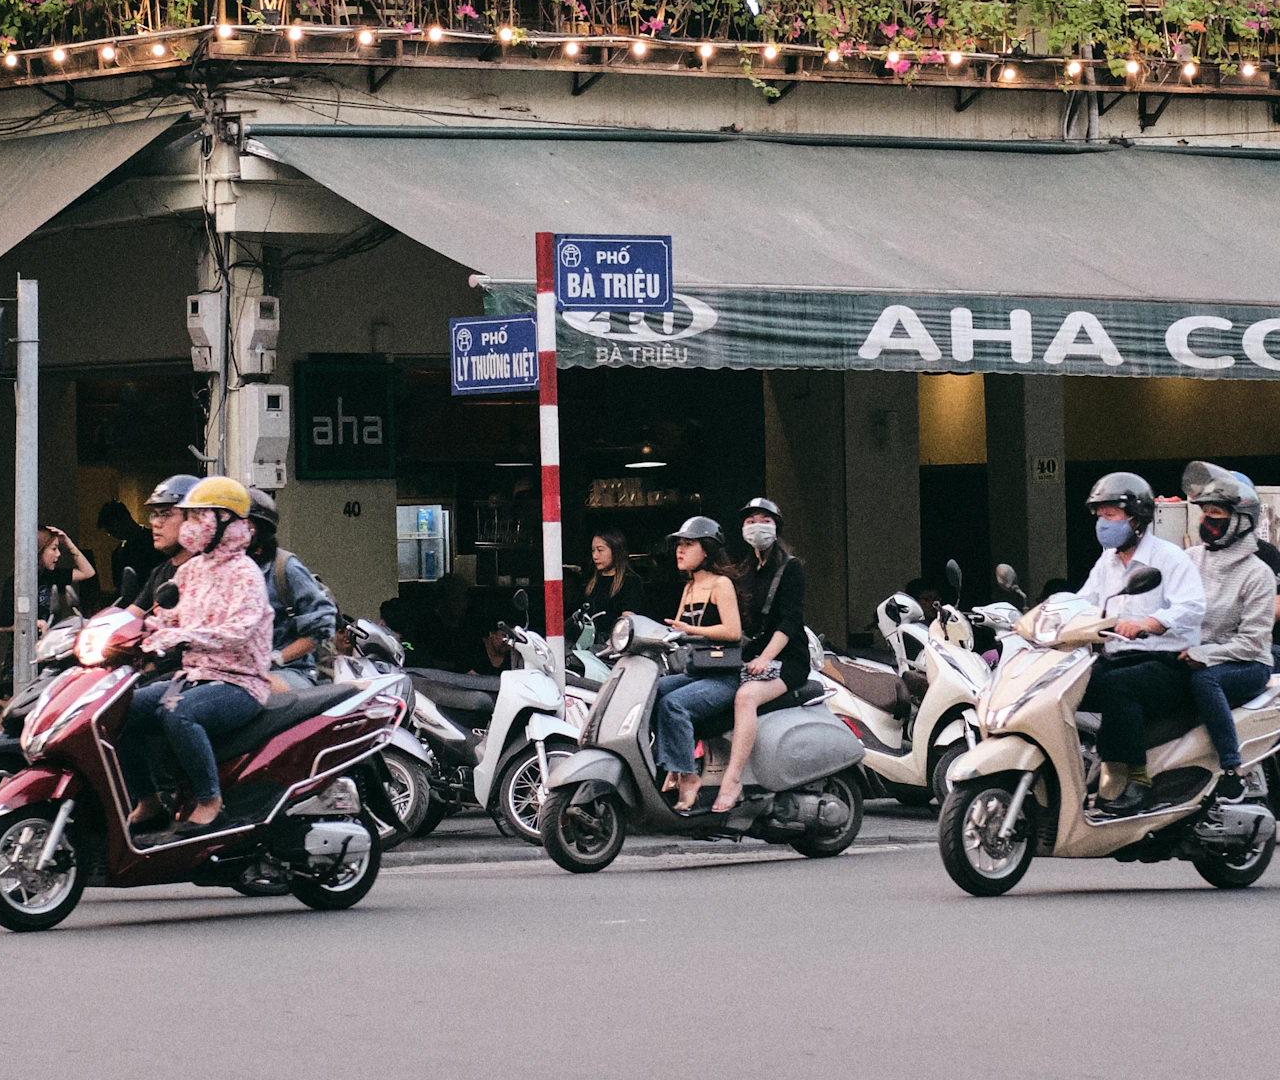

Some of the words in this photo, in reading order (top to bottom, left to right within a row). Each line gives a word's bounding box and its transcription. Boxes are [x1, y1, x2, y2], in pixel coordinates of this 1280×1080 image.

[596, 245, 631, 265] PHỐ
[567, 267, 597, 299] BÀ
[601, 267, 661, 304] TRIỆU
[481, 324, 509, 347] PHỐ
[857, 304, 1125, 367] AHA
[457, 351, 470, 383] LÝ
[512, 346, 535, 383] KIỆT
[595, 342, 624, 364] BÀ
[311, 396, 384, 445] aha
[342, 500, 363, 518] 40
